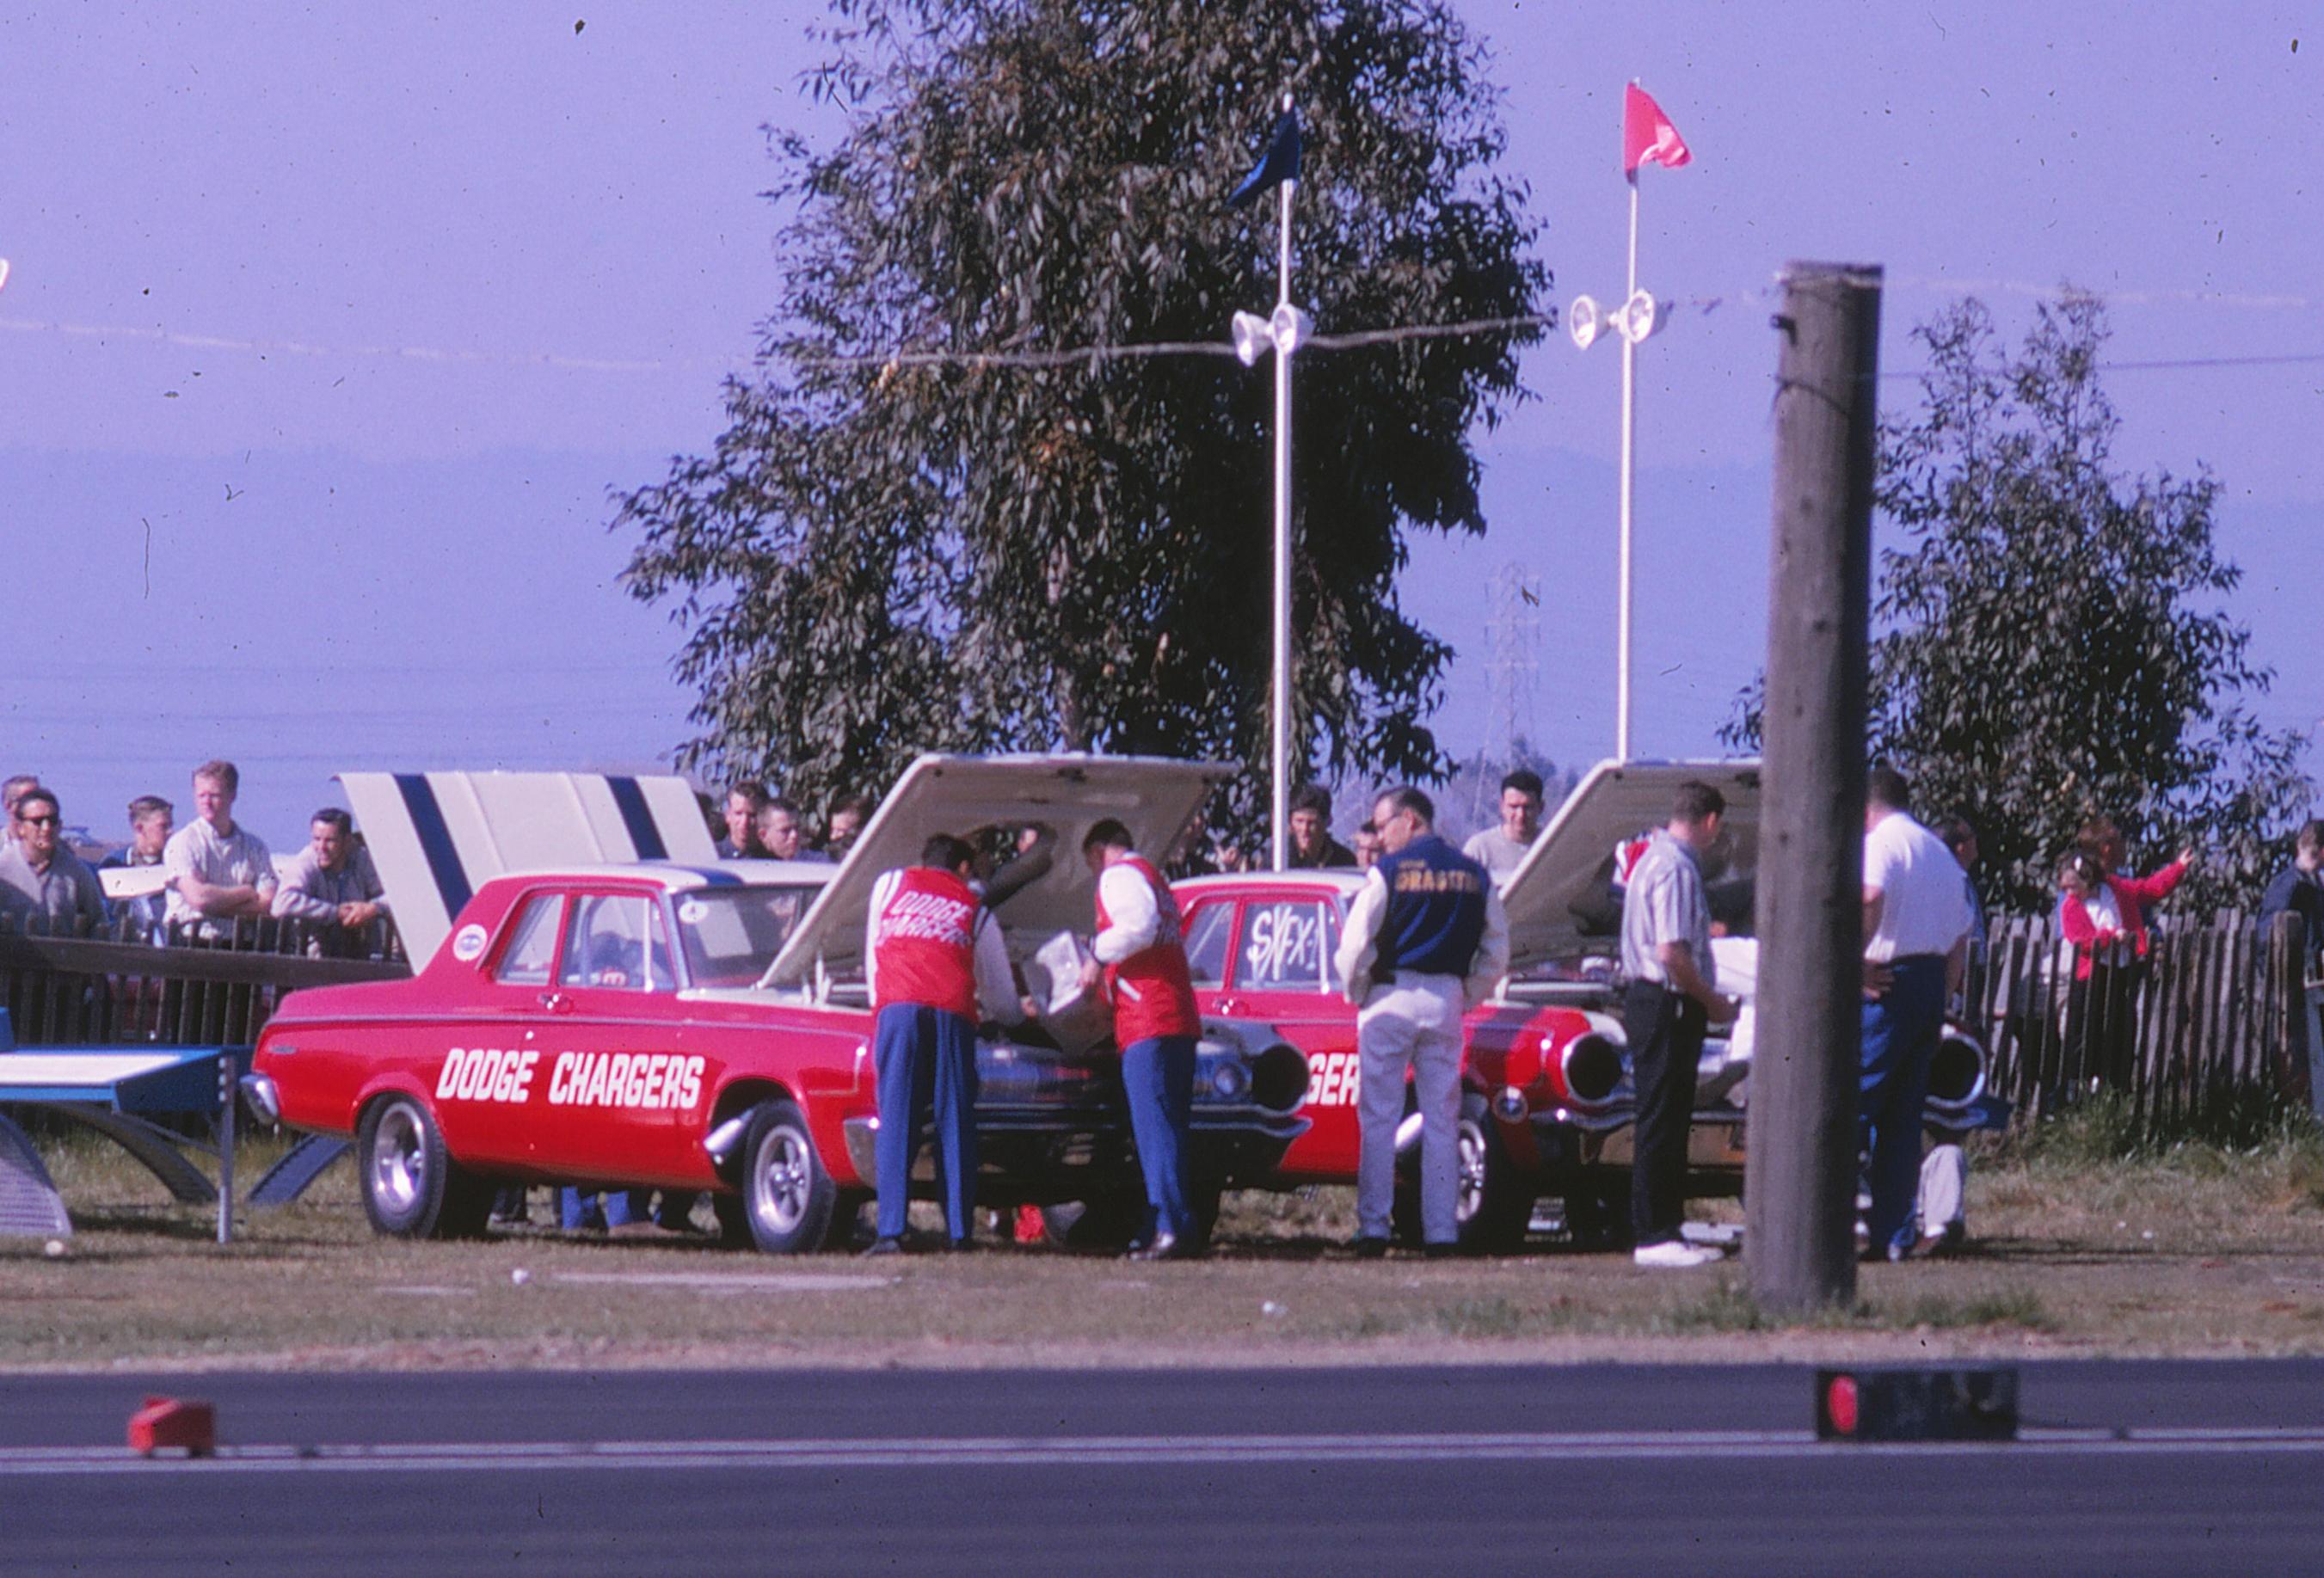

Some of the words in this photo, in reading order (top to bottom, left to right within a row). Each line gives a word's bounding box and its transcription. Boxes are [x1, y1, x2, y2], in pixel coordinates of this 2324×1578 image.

[889, 891, 971, 925] DODGE
[435, 1047, 539, 1103] DODGE
[548, 1051, 705, 1109] CHARGERS
